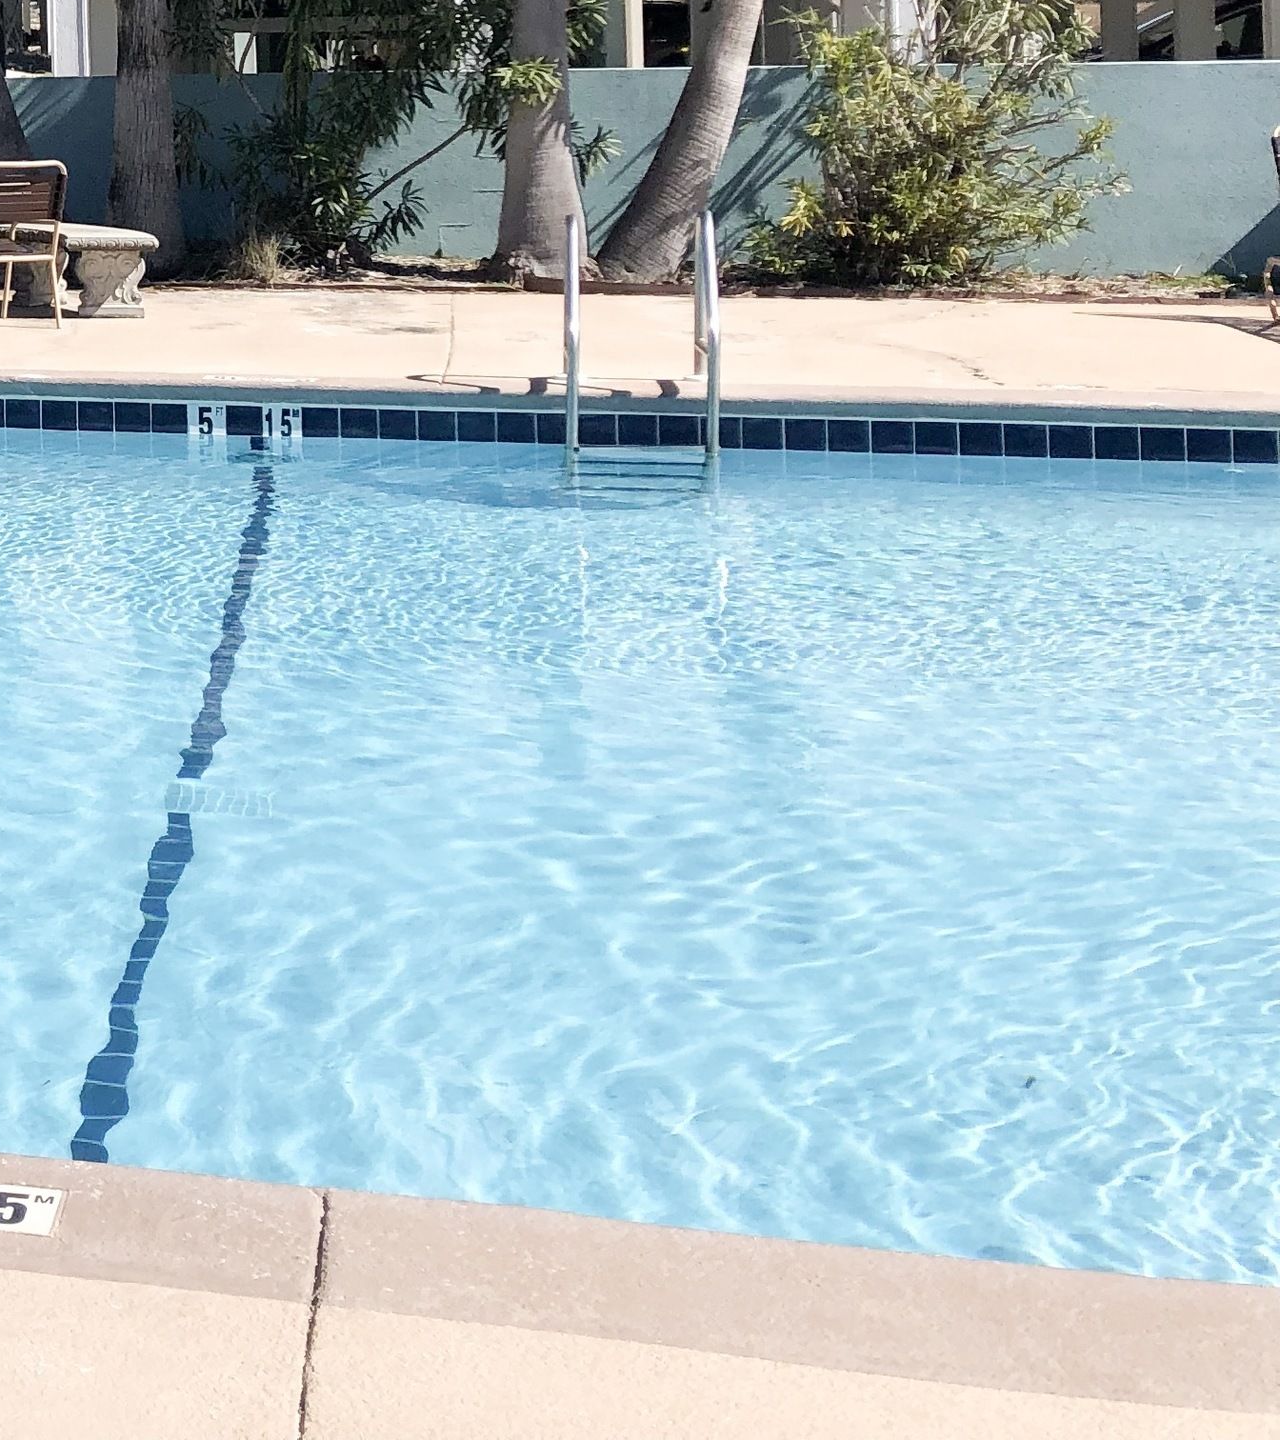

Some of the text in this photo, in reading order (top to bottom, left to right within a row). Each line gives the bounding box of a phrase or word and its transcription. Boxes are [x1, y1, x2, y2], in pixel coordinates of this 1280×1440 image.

[198, 406, 213, 435] 5
[215, 406, 224, 416] FT
[34, 1193, 55, 1205] M
